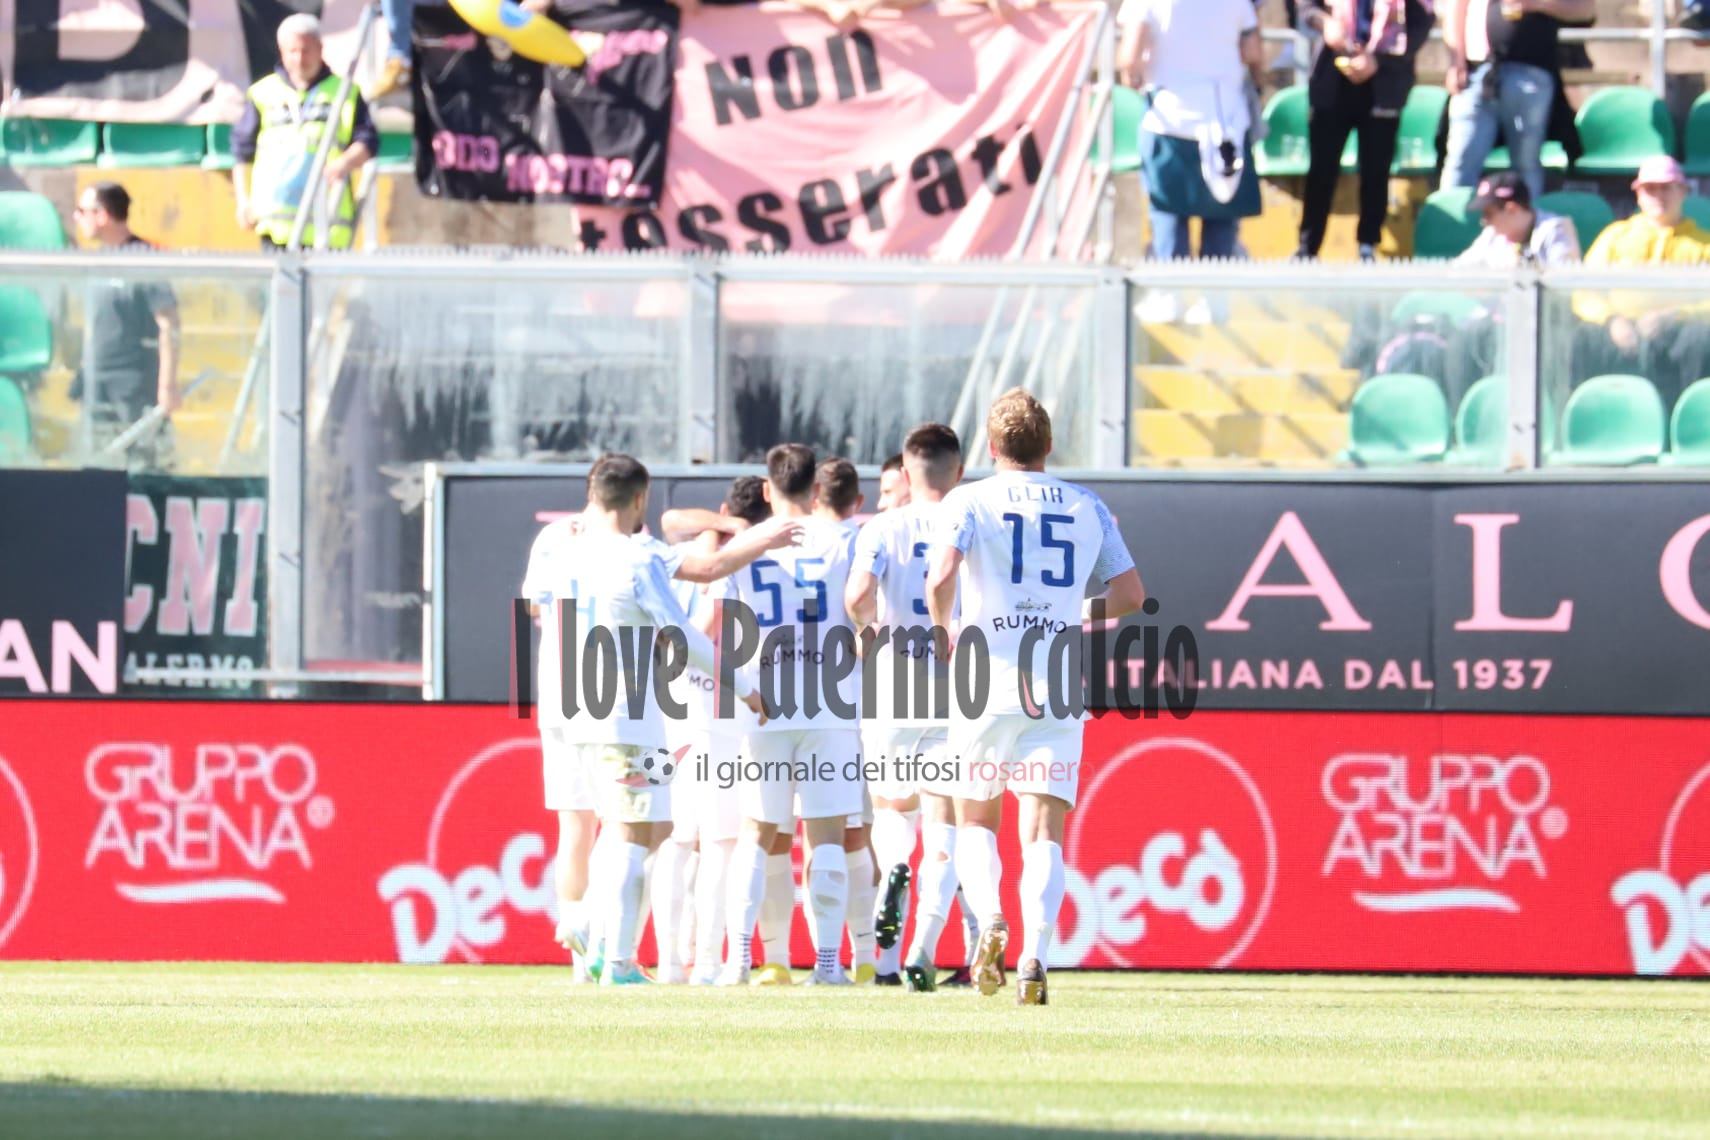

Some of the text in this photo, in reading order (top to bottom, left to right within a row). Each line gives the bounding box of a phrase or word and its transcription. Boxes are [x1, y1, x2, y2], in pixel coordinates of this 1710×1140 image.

[1003, 512, 1075, 587] 15
[751, 557, 828, 627] 55
[992, 614, 1067, 634] RUMMO
[760, 648, 826, 669] RUMMO
[1107, 658, 1553, 691] ITALIANA DAL 1937
[84, 742, 317, 802] GRUPPO
[1321, 753, 1551, 813] GRUPPO
[84, 801, 312, 870] ARENA
[1320, 812, 1548, 880] ARENA
[376, 833, 562, 963] Dec
